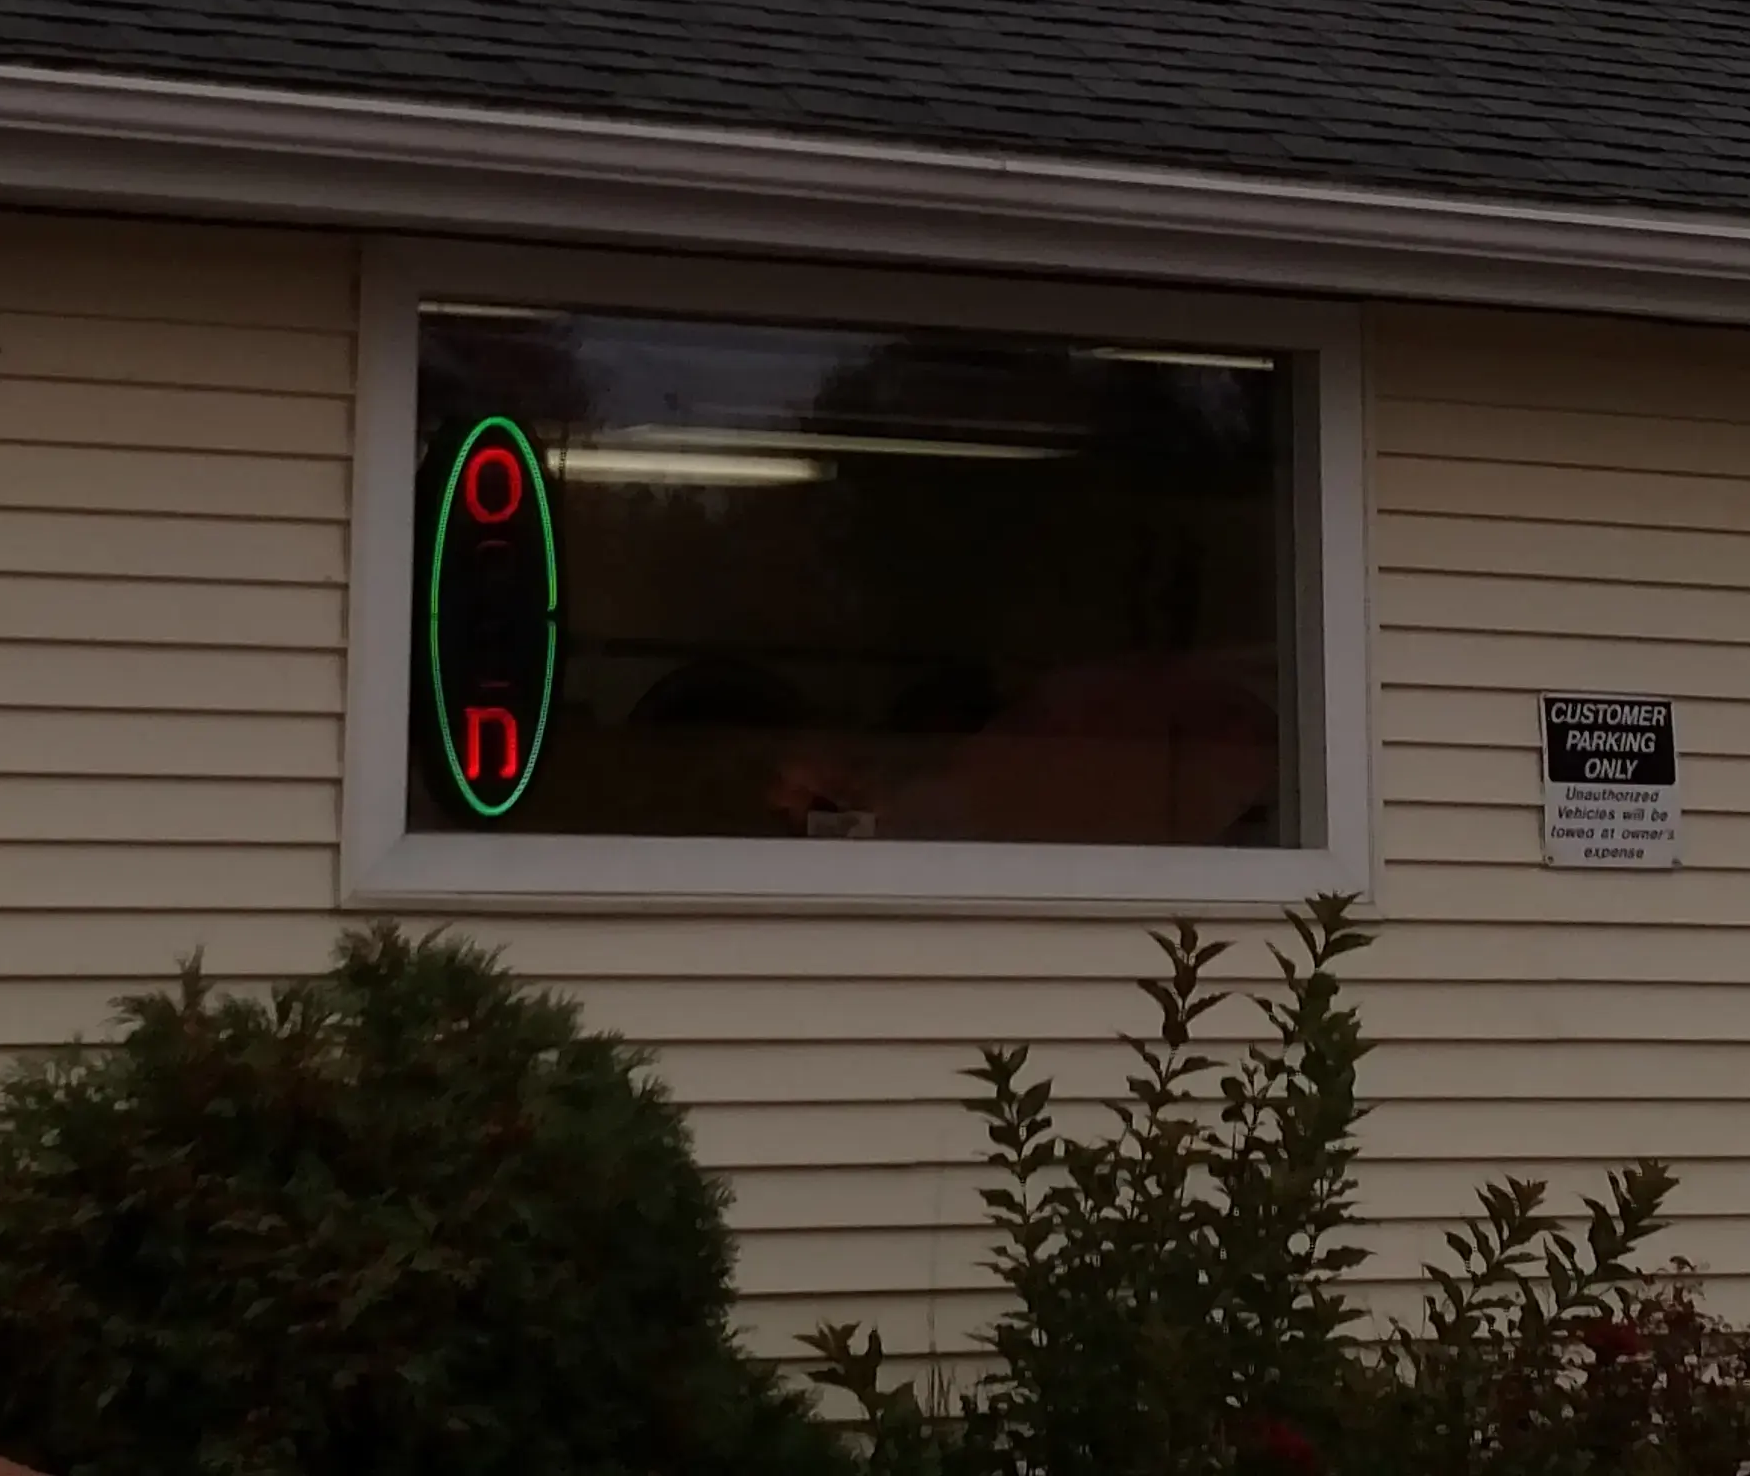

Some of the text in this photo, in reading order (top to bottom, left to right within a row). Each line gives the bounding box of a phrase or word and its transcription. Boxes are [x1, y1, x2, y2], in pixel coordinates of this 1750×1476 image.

[1551, 702, 1667, 727] CUSTOMER
[1566, 729, 1656, 753] PARKING
[1584, 757, 1639, 780] ONLY
[1565, 786, 1659, 802] Unauthorized
[1557, 806, 1668, 822] Vehicles will be
[1551, 825, 1594, 839] towed
[1601, 826, 1615, 839] at
[1583, 846, 1644, 860] expense
